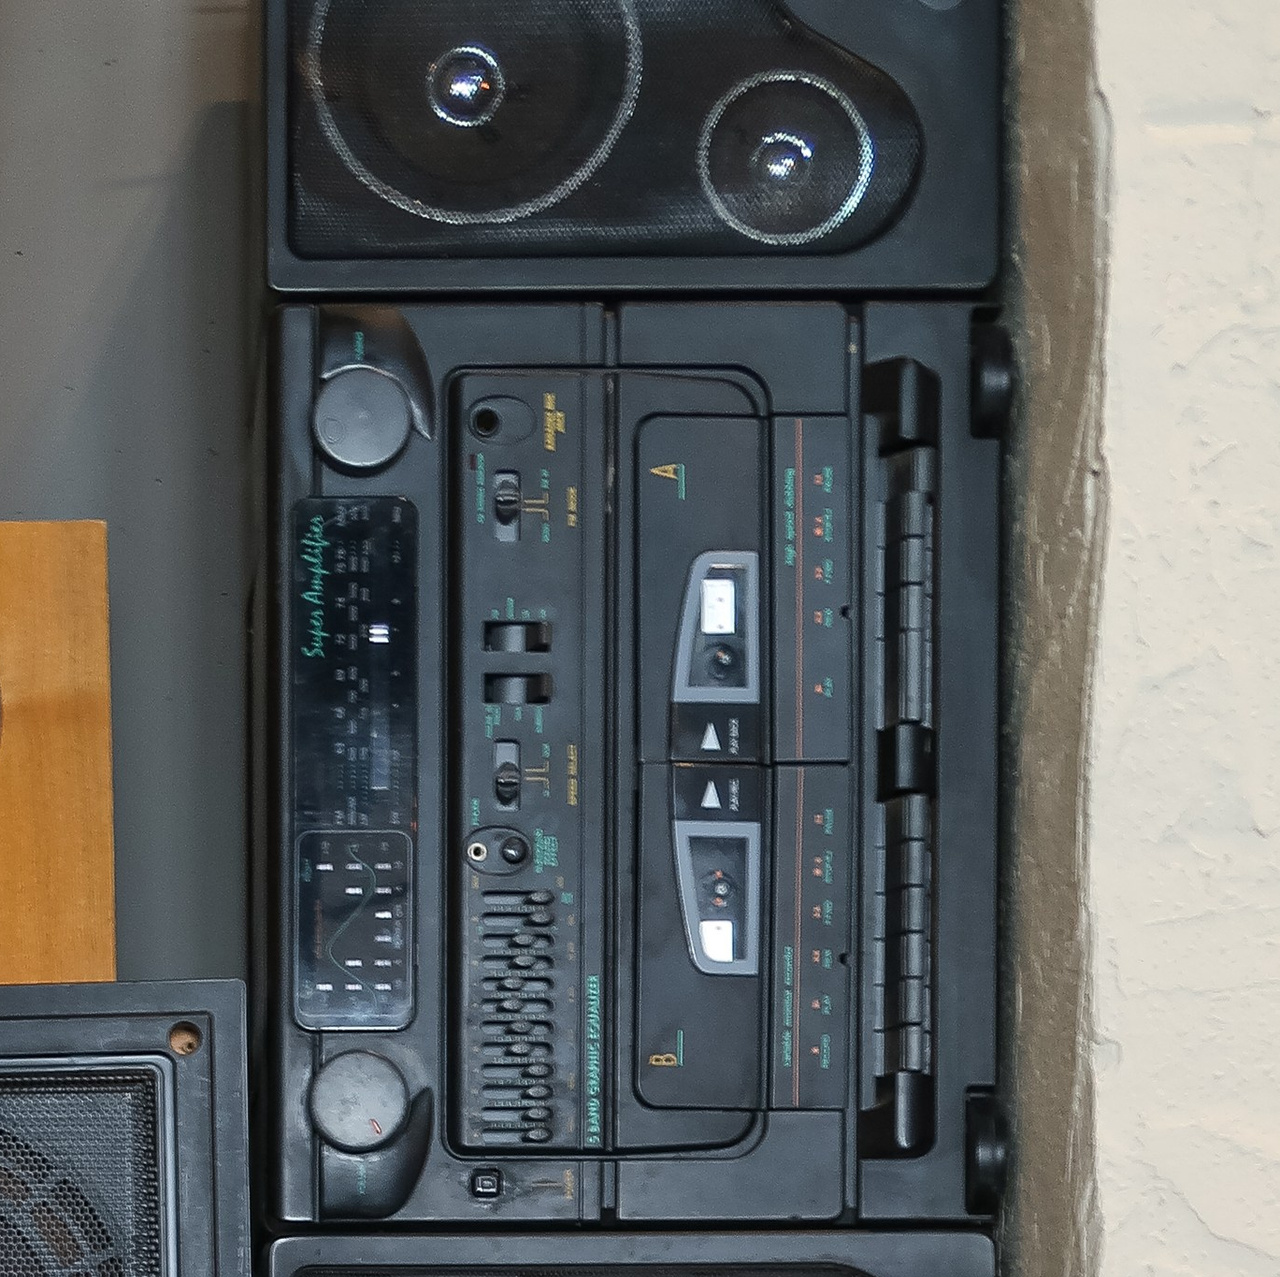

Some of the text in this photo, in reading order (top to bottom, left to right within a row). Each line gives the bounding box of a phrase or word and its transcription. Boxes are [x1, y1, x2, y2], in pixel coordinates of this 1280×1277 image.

[648, 463, 679, 480] A
[299, 514, 331, 658] Super Amplifier
[586, 974, 601, 1040] EQUALIZER
[586, 1041, 601, 1096] GRAPHIC
[648, 1052, 677, 1068] B
[586, 1097, 601, 1133] BAND
